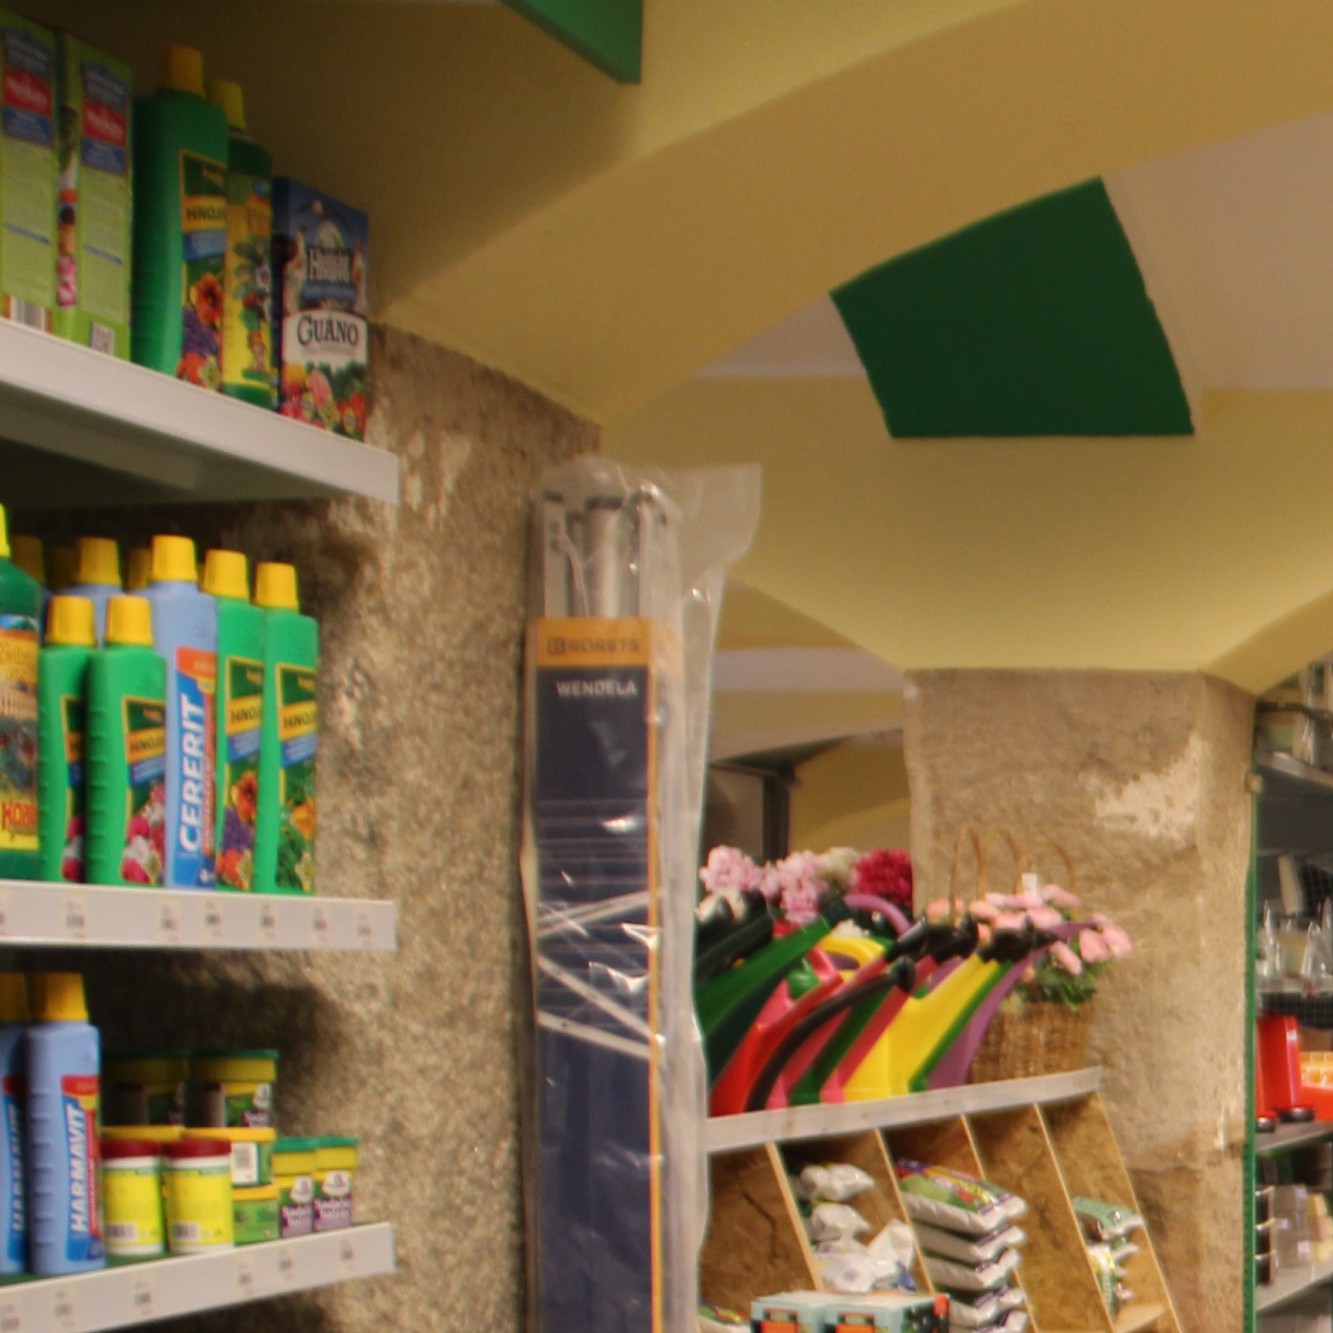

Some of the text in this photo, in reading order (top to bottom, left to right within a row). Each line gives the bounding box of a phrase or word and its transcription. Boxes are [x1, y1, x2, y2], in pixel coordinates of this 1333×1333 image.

[297, 316, 360, 346] GUANO
[556, 681, 637, 697] WENDELA
[66, 1102, 87, 1232] HARMAVIT
